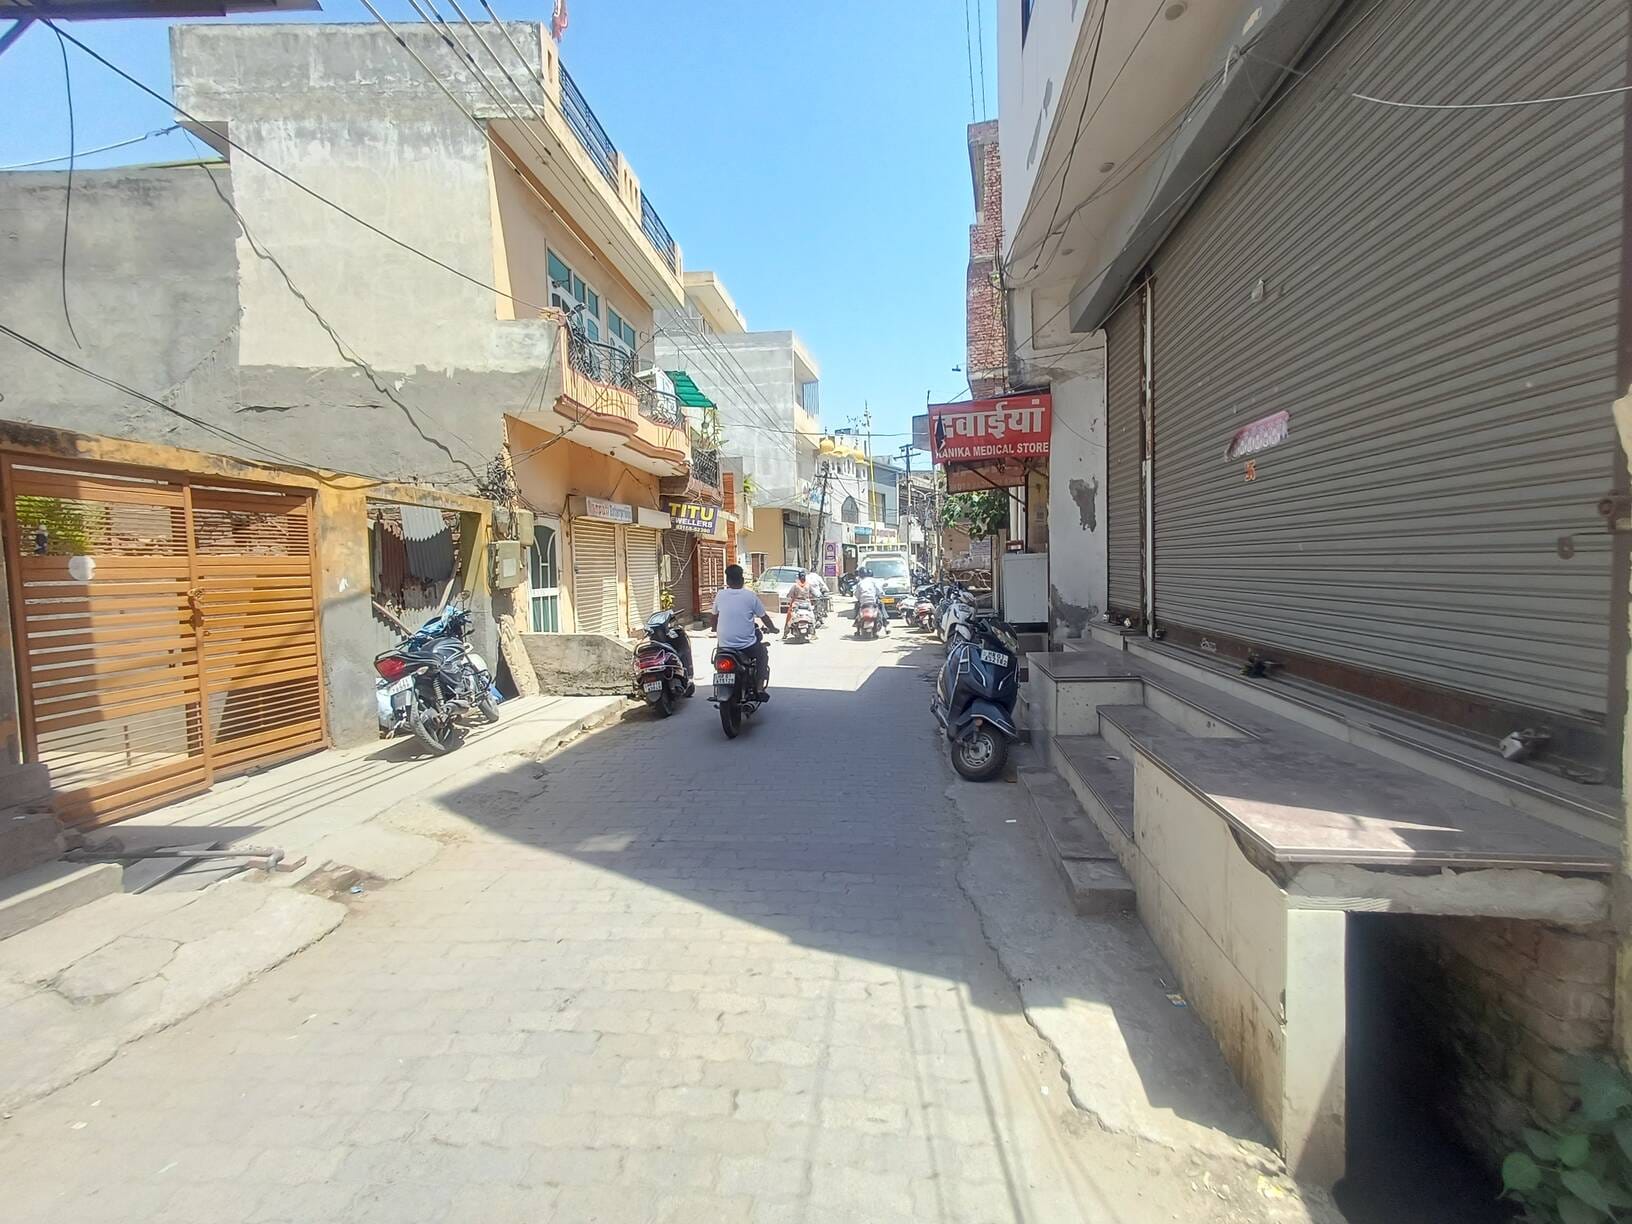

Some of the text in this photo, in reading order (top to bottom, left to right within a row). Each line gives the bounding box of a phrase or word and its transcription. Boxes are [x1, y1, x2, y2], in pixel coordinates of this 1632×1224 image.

[973, 444, 1014, 457] MEDICAL
[1017, 442, 1049, 454] STORE
[669, 502, 714, 521] TITU
